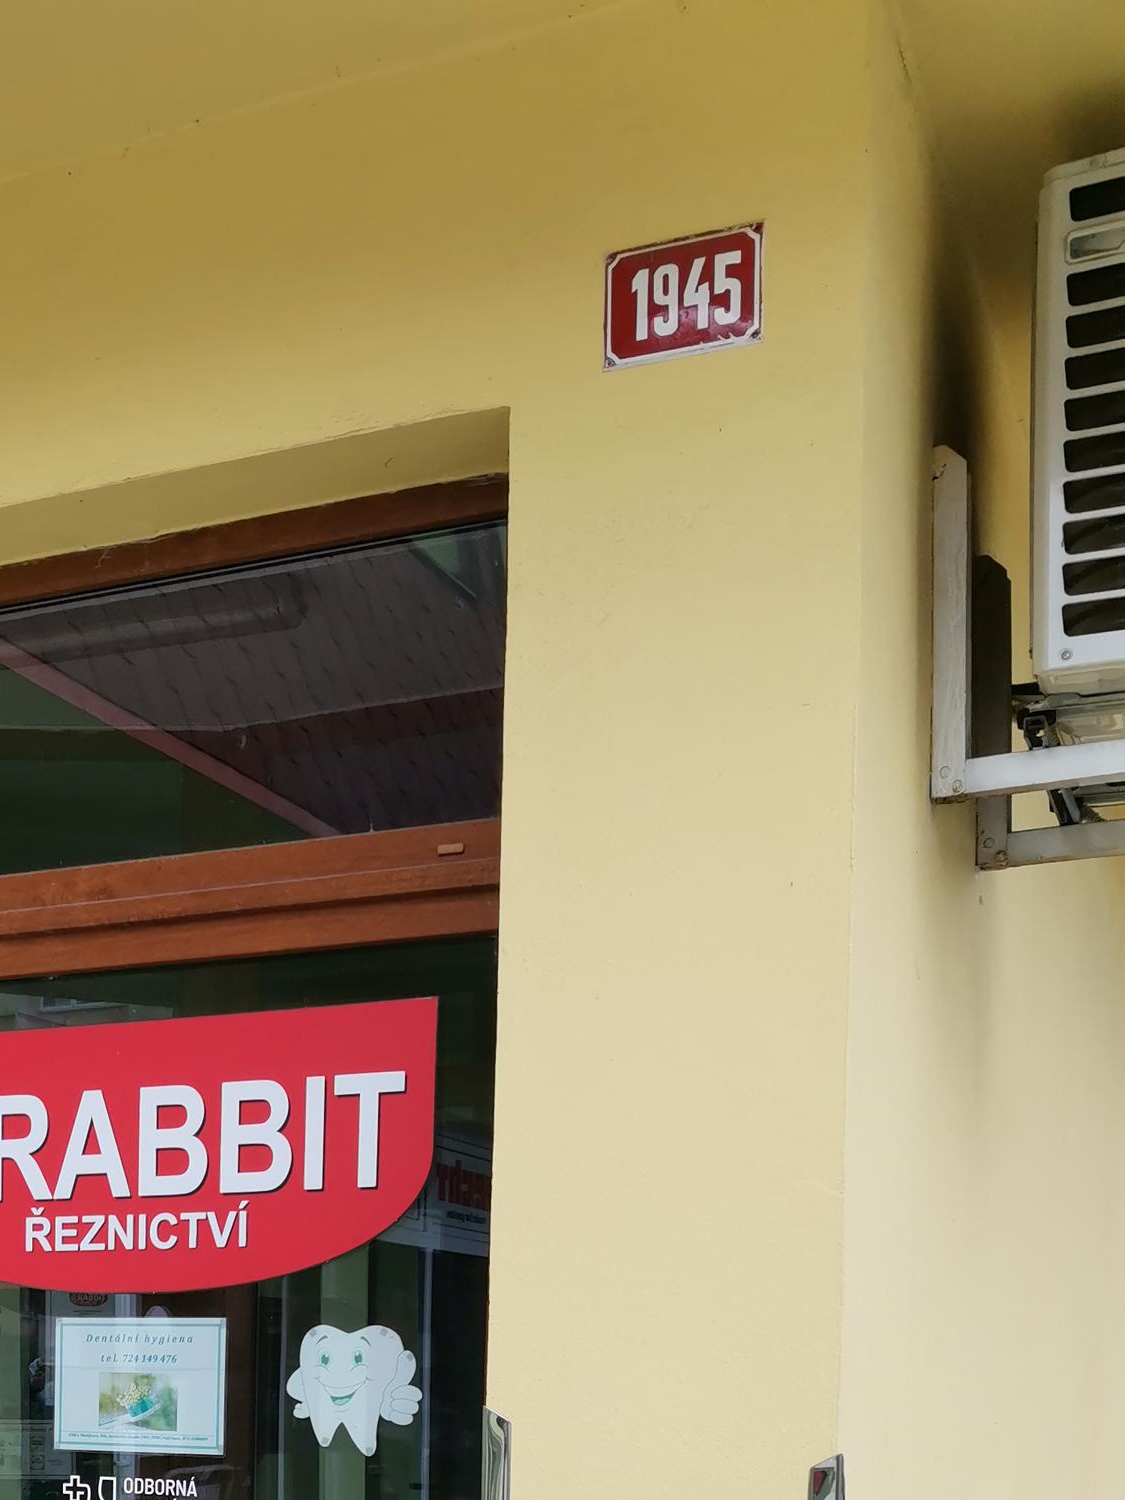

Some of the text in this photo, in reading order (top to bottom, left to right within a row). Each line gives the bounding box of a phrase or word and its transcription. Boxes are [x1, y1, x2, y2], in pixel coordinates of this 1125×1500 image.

[631, 250, 742, 342] 1945
[25, 1200, 249, 1253] ŘEZNICTVÍ
[144, 1333, 194, 1345] hygiena
[101, 1353, 178, 1364] tel. 724 149 476
[123, 1476, 198, 1498] ODBORNÁ
